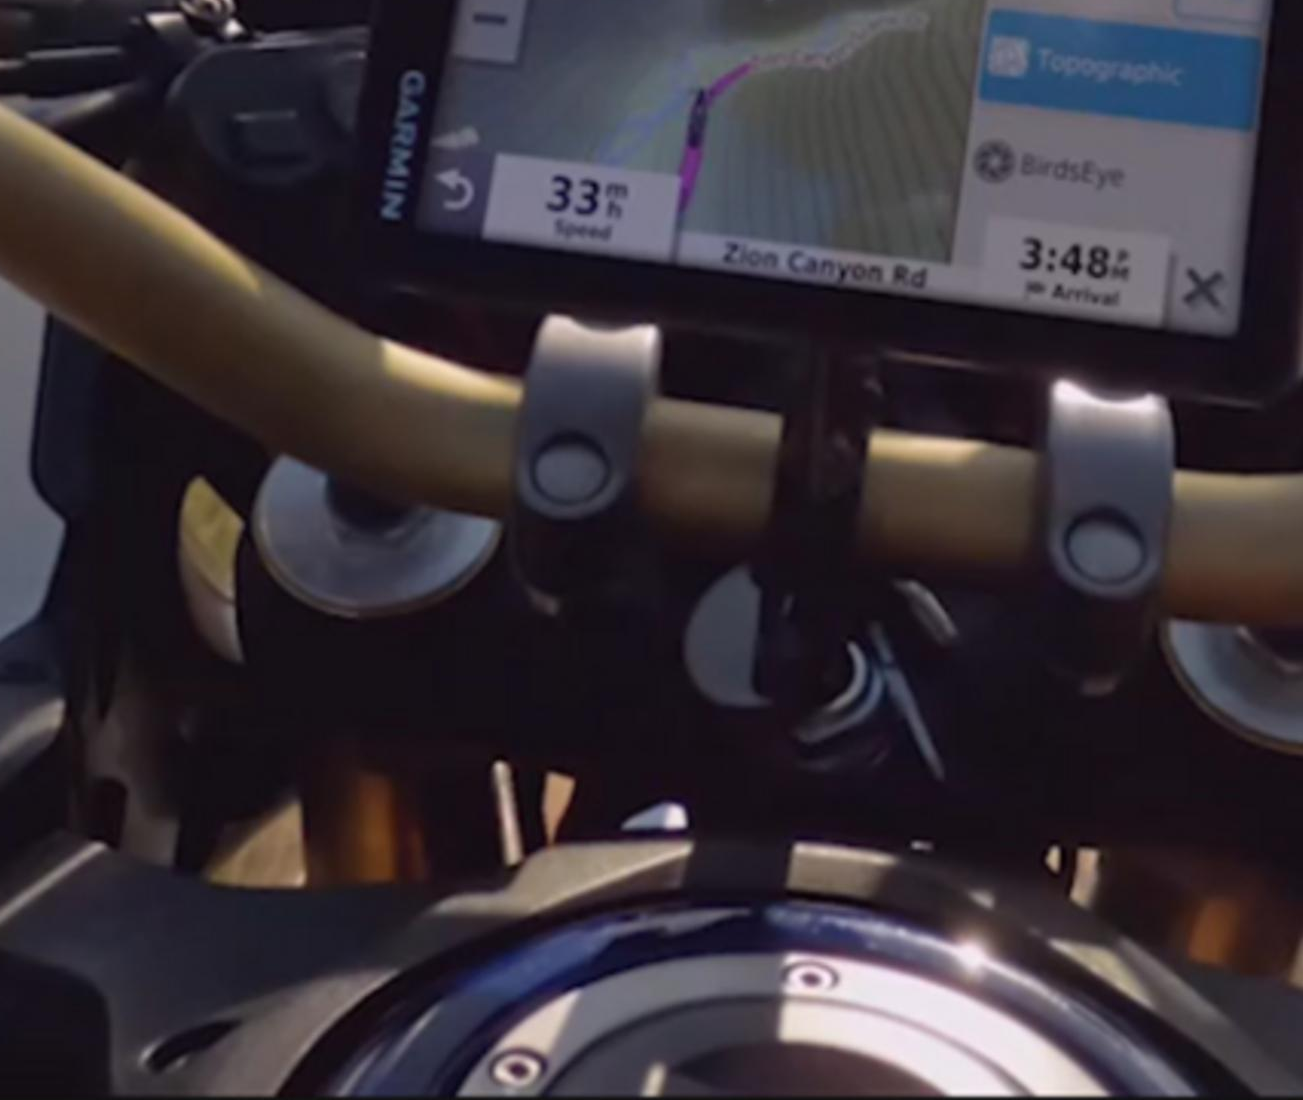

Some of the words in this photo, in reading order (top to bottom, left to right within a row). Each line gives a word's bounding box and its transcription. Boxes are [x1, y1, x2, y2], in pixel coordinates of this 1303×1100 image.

[1037, 46, 1185, 87] Topographic
[380, 69, 426, 221] GARMIN
[1020, 151, 1126, 191] BirdsEye
[546, 175, 601, 216] 33
[554, 219, 613, 242] Speed
[723, 240, 779, 268] Zion
[788, 251, 883, 284] Canyon
[892, 263, 928, 289] Rd
[1052, 283, 1120, 307] Arrival
